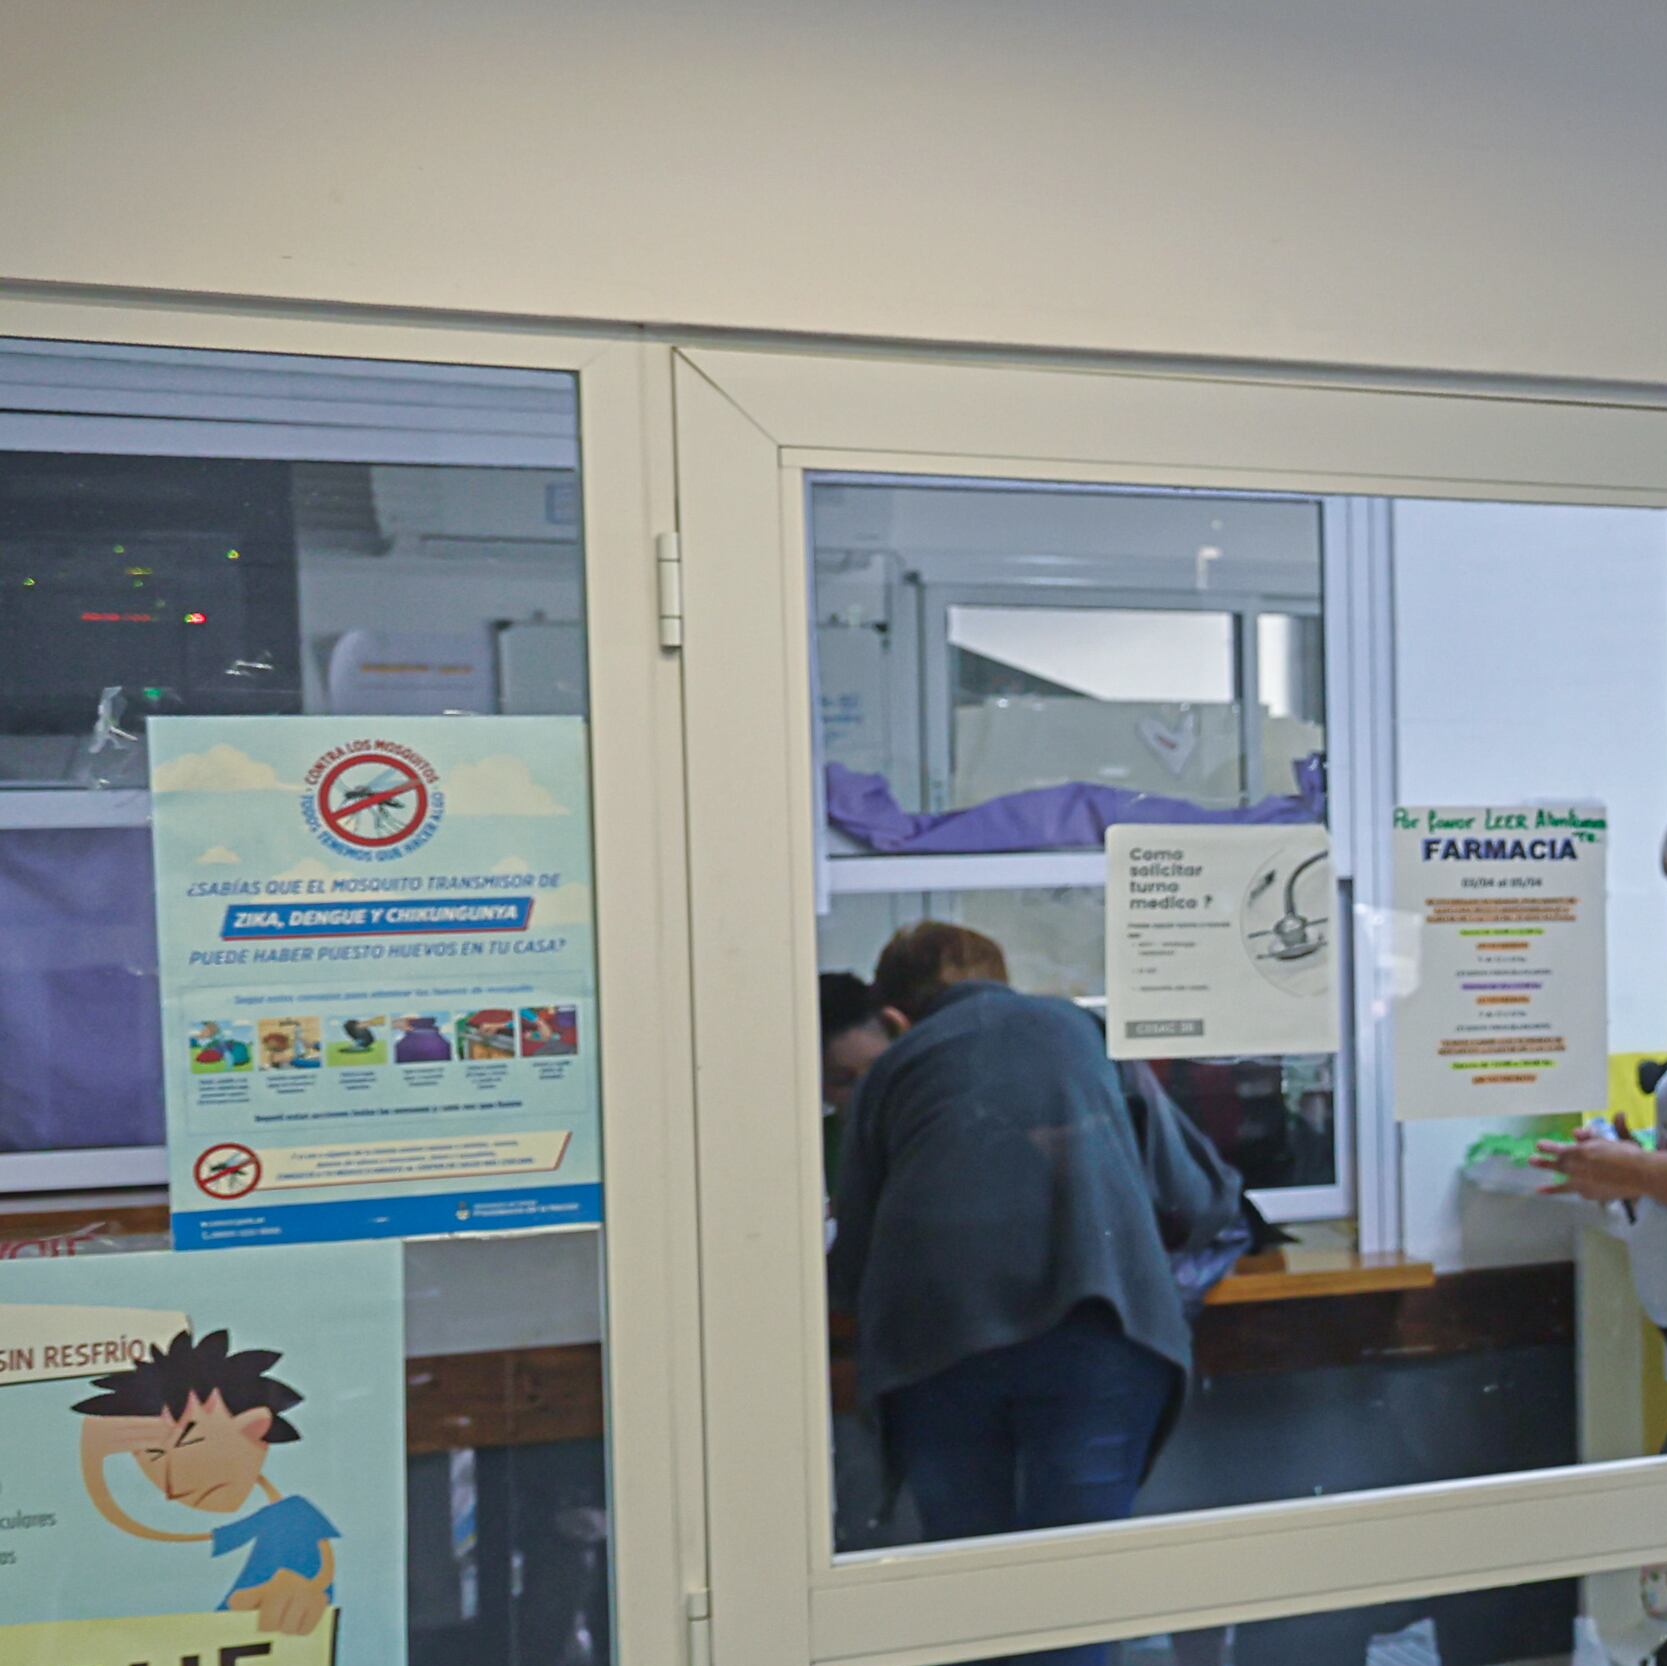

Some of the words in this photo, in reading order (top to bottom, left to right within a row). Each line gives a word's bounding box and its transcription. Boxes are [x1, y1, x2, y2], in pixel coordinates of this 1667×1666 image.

[304, 747, 345, 785] CONTRA
[346, 739, 372, 755] LOS
[374, 739, 440, 784] MOSQUITOS
[1423, 838, 1578, 861] FARMACIA
[1130, 863, 1203, 877] solicitar
[187, 877, 261, 896] ¿SABÍAS
[265, 880, 303, 895] QUE
[306, 880, 325, 894] EL
[331, 876, 423, 894] MOSQUITO
[428, 873, 536, 891] TRANSMISOR
[539, 873, 561, 888] DE
[1130, 881, 1180, 893] turno
[233, 912, 286, 929] ZIKA,
[289, 909, 368, 926] DENGUE
[371, 908, 385, 924] Y
[385, 904, 519, 923] CHIKUNGUNYA
[188, 950, 249, 966] PUEDE
[253, 947, 314, 964] HABER
[317, 945, 386, 961] PUESTO
[387, 942, 458, 958] HUEVOS
[460, 941, 483, 956] EN
[489, 940, 510, 955] TU
[513, 939, 567, 954] CASA?
[44, 1335, 145, 1370] RESFRÍO
